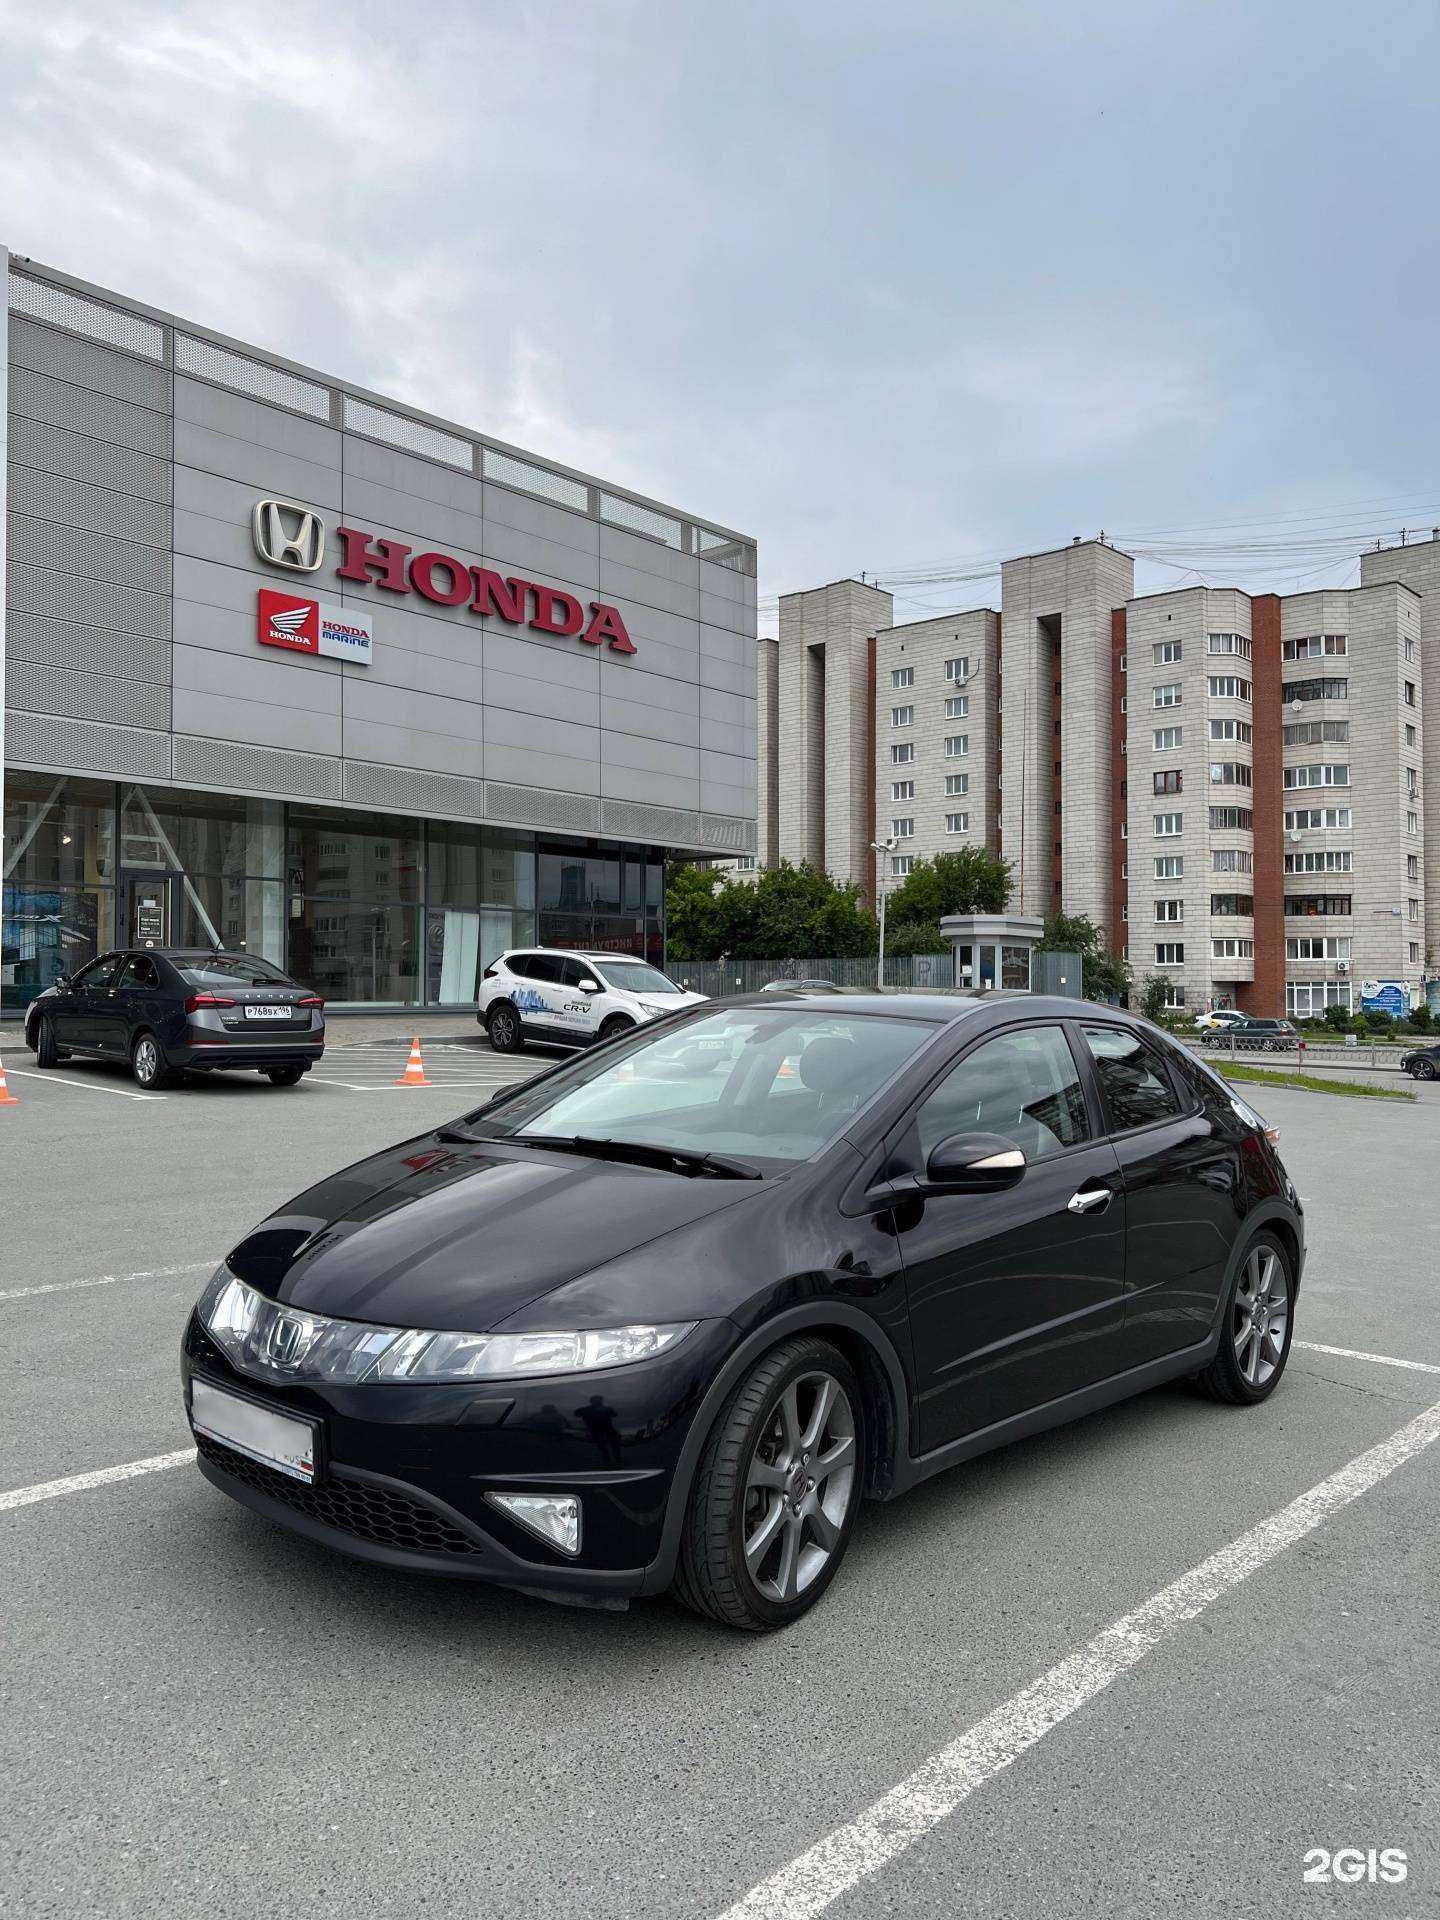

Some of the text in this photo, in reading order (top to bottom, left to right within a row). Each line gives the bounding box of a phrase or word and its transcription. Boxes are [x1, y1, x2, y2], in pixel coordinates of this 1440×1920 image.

[336, 527, 637, 655] HONDA
[269, 630, 312, 645] HONDA
[321, 620, 370, 639] HONDA
[563, 1003, 591, 1014] CR-V
